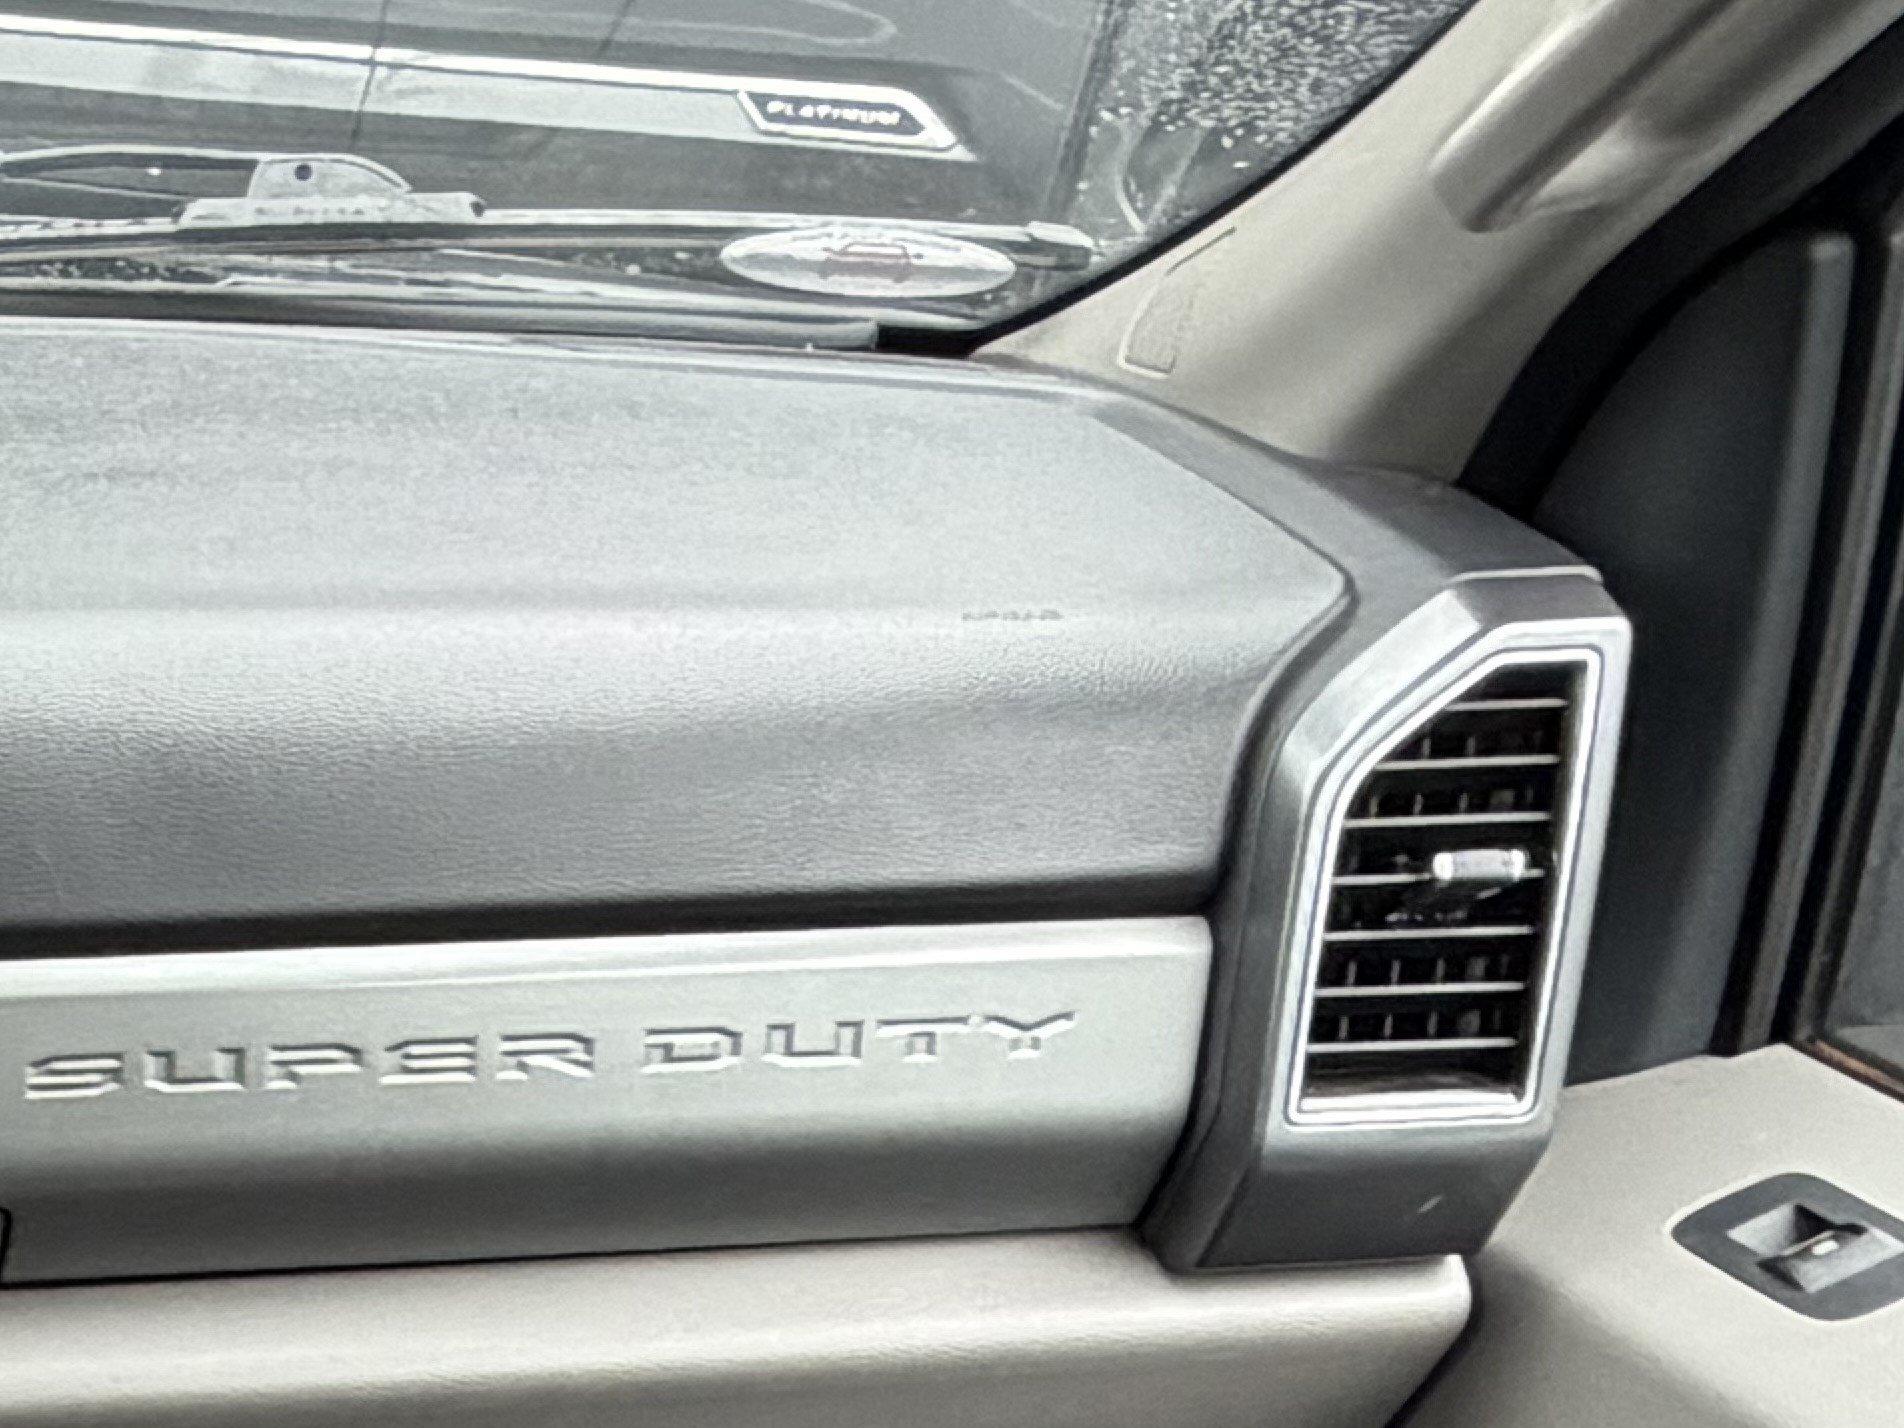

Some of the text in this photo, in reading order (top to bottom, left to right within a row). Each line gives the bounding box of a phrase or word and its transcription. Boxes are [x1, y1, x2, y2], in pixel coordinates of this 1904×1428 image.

[766, 100, 901, 125] PLATINUM
[23, 1011, 1077, 1101] SUPER DUTY
